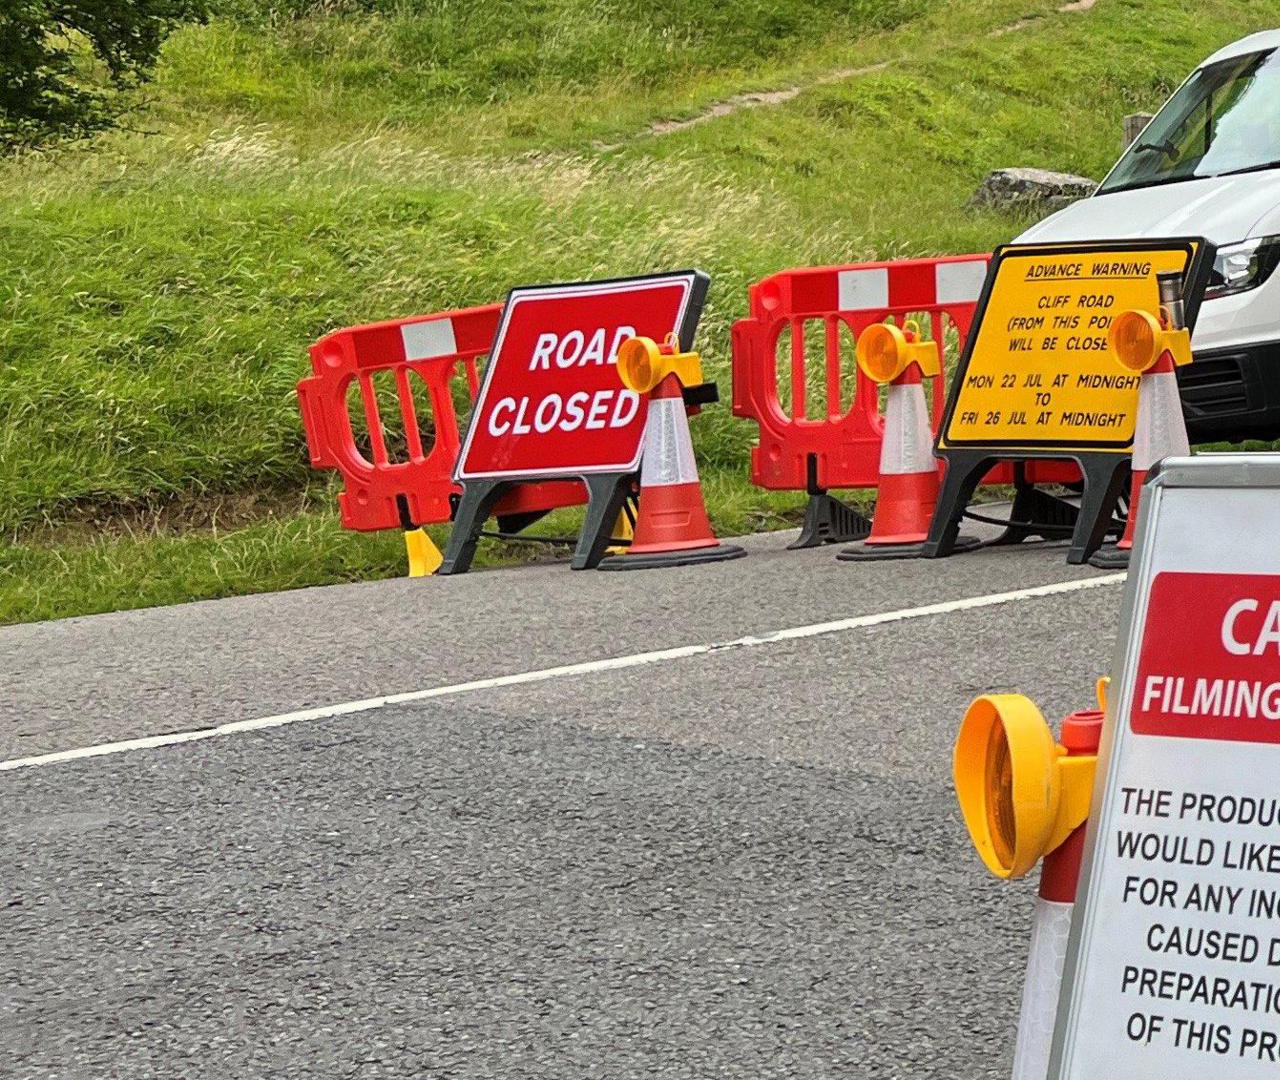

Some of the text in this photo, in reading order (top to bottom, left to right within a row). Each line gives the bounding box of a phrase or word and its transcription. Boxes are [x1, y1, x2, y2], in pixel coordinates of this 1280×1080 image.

[1025, 262, 1152, 278] ADVANCE WARNING
[1038, 295, 1114, 309] CLIFF ROAD
[1008, 315, 1113, 331] (FROM THIS POI
[529, 326, 637, 371] ROAD
[1009, 336, 1108, 351] WILL BE CLOSE
[966, 374, 1141, 390] MON 22 JUL AT MIDNIGHT
[1035, 393, 1051, 407] TO
[487, 389, 640, 437] CLOSED
[960, 412, 1126, 427] FRI 26 JUL AT MIDNIGHT
[1121, 787, 1171, 818] THE
[1117, 832, 1214, 866] WOULD
[1122, 877, 1178, 908] FOR
[1184, 883, 1242, 914] ANY
[1146, 924, 1258, 964] CAUSED
[1127, 1013, 1168, 1043] OF
[1171, 1018, 1232, 1054] THIS
